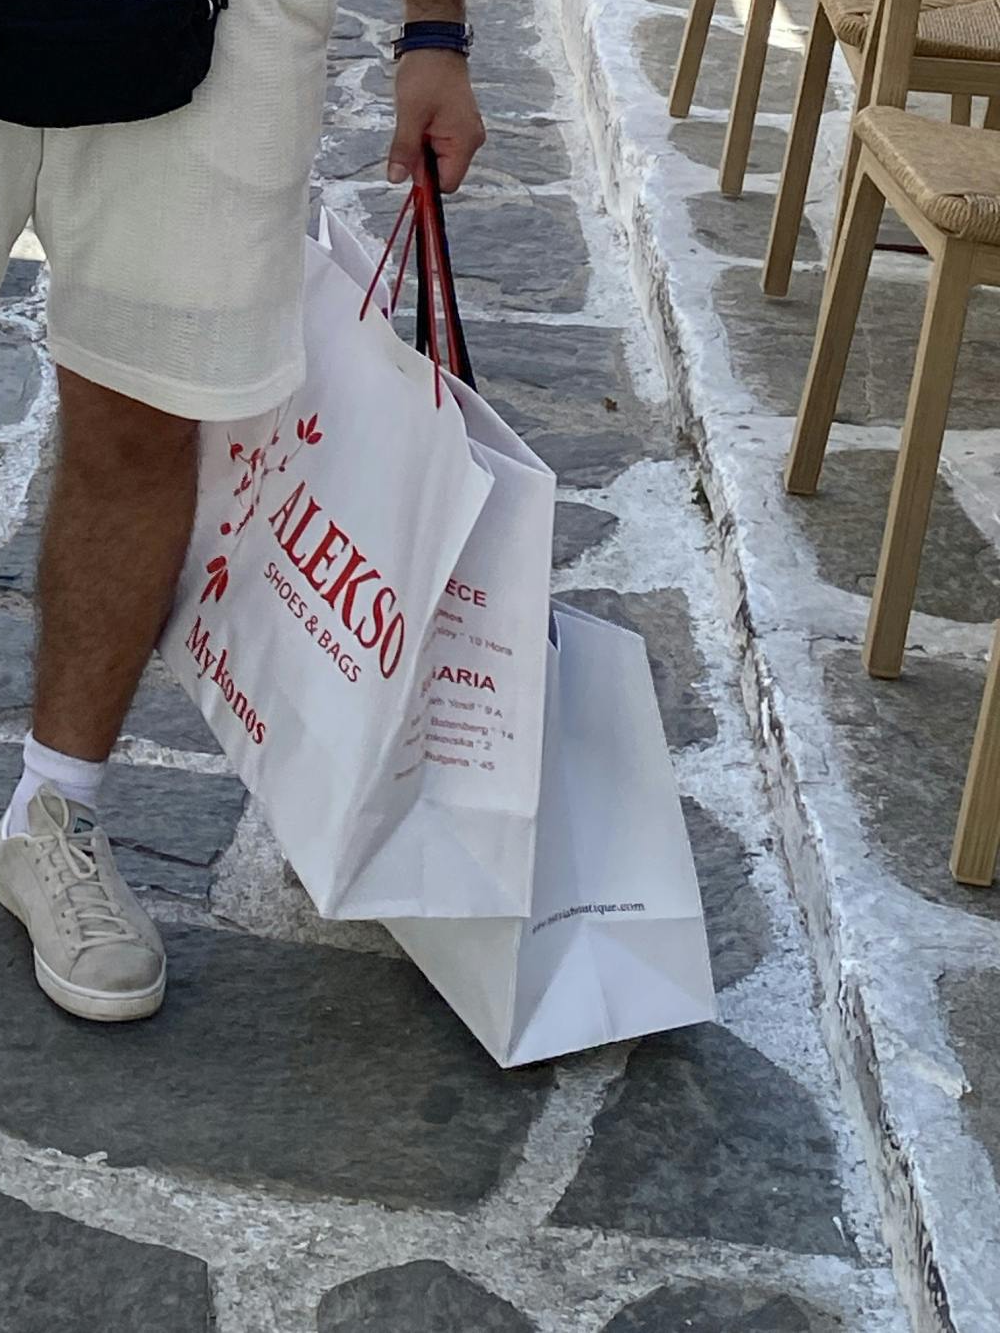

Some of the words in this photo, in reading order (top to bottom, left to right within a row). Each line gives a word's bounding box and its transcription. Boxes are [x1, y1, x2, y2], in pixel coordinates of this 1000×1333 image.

[264, 562, 308, 619] SHOES
[305, 615, 319, 636] &
[317, 629, 362, 683] BAGS
[268, 481, 405, 680] ALEKSO
[444, 578, 487, 608] ECE
[185, 616, 266, 744] Mykonos
